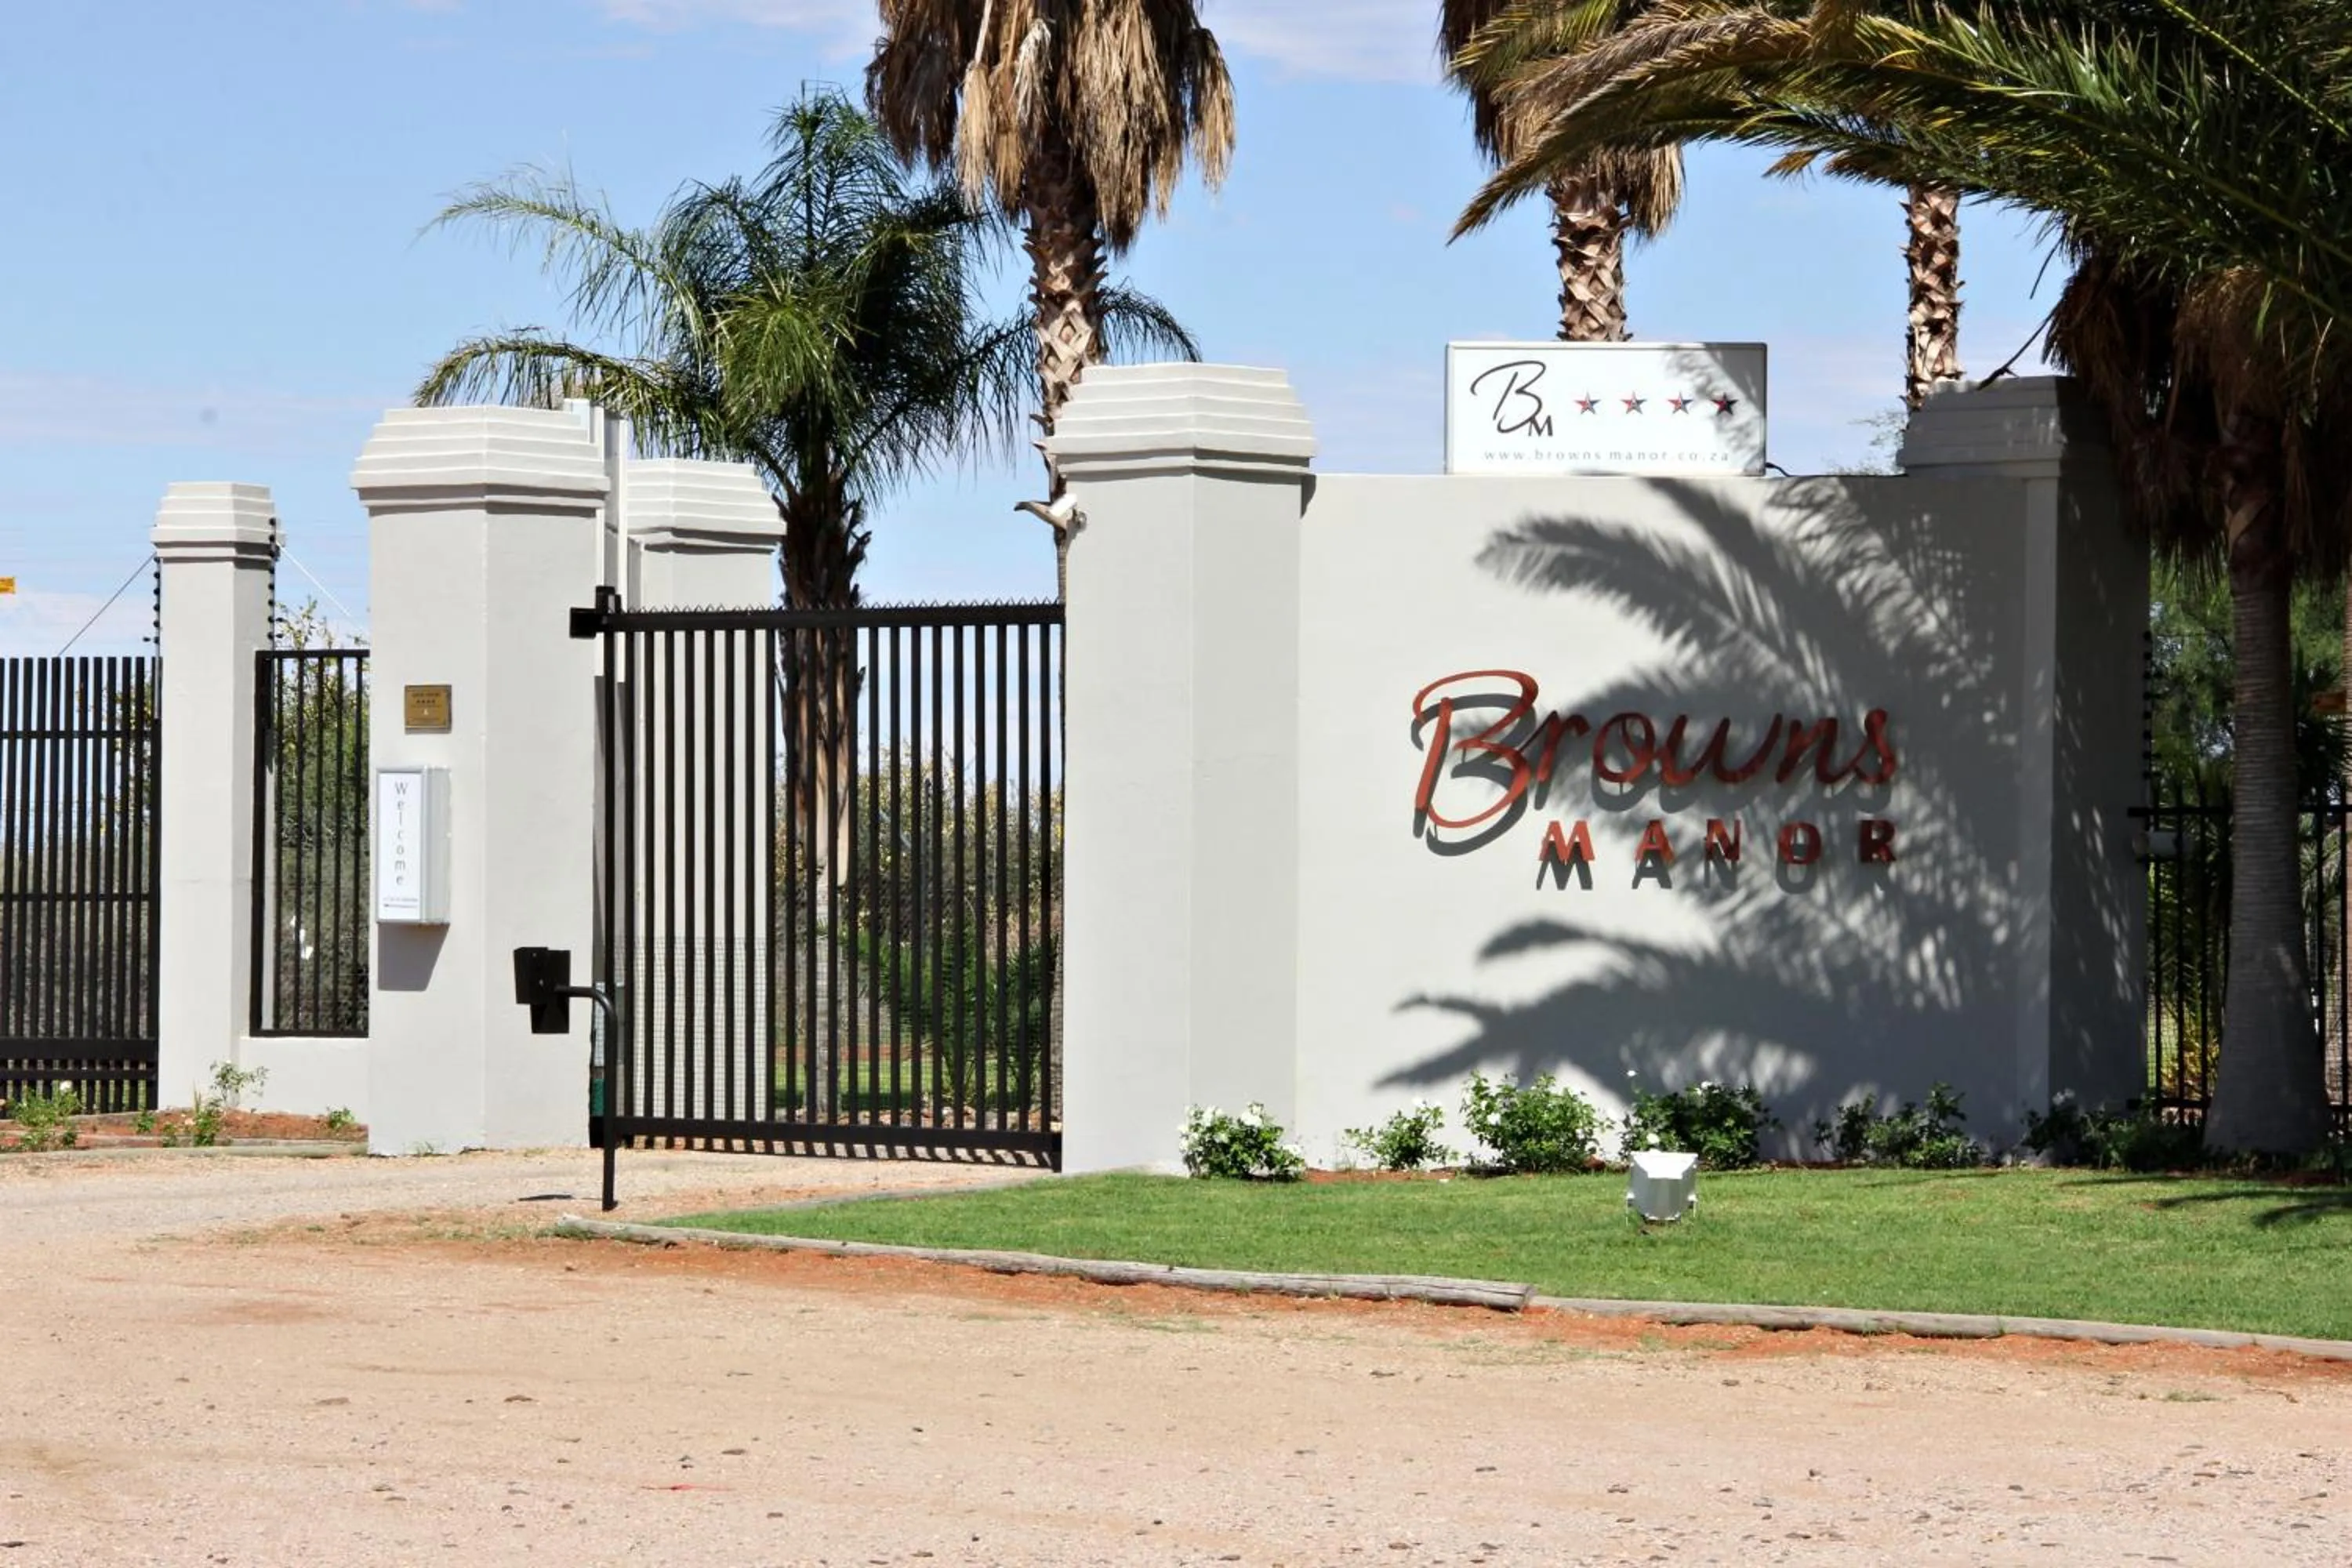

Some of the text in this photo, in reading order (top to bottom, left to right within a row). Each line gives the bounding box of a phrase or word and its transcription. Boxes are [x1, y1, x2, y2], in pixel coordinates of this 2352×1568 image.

[1413, 670, 1896, 828] Browns
[394, 782, 408, 885] Welcome
[1539, 819, 1896, 863] MANOR
